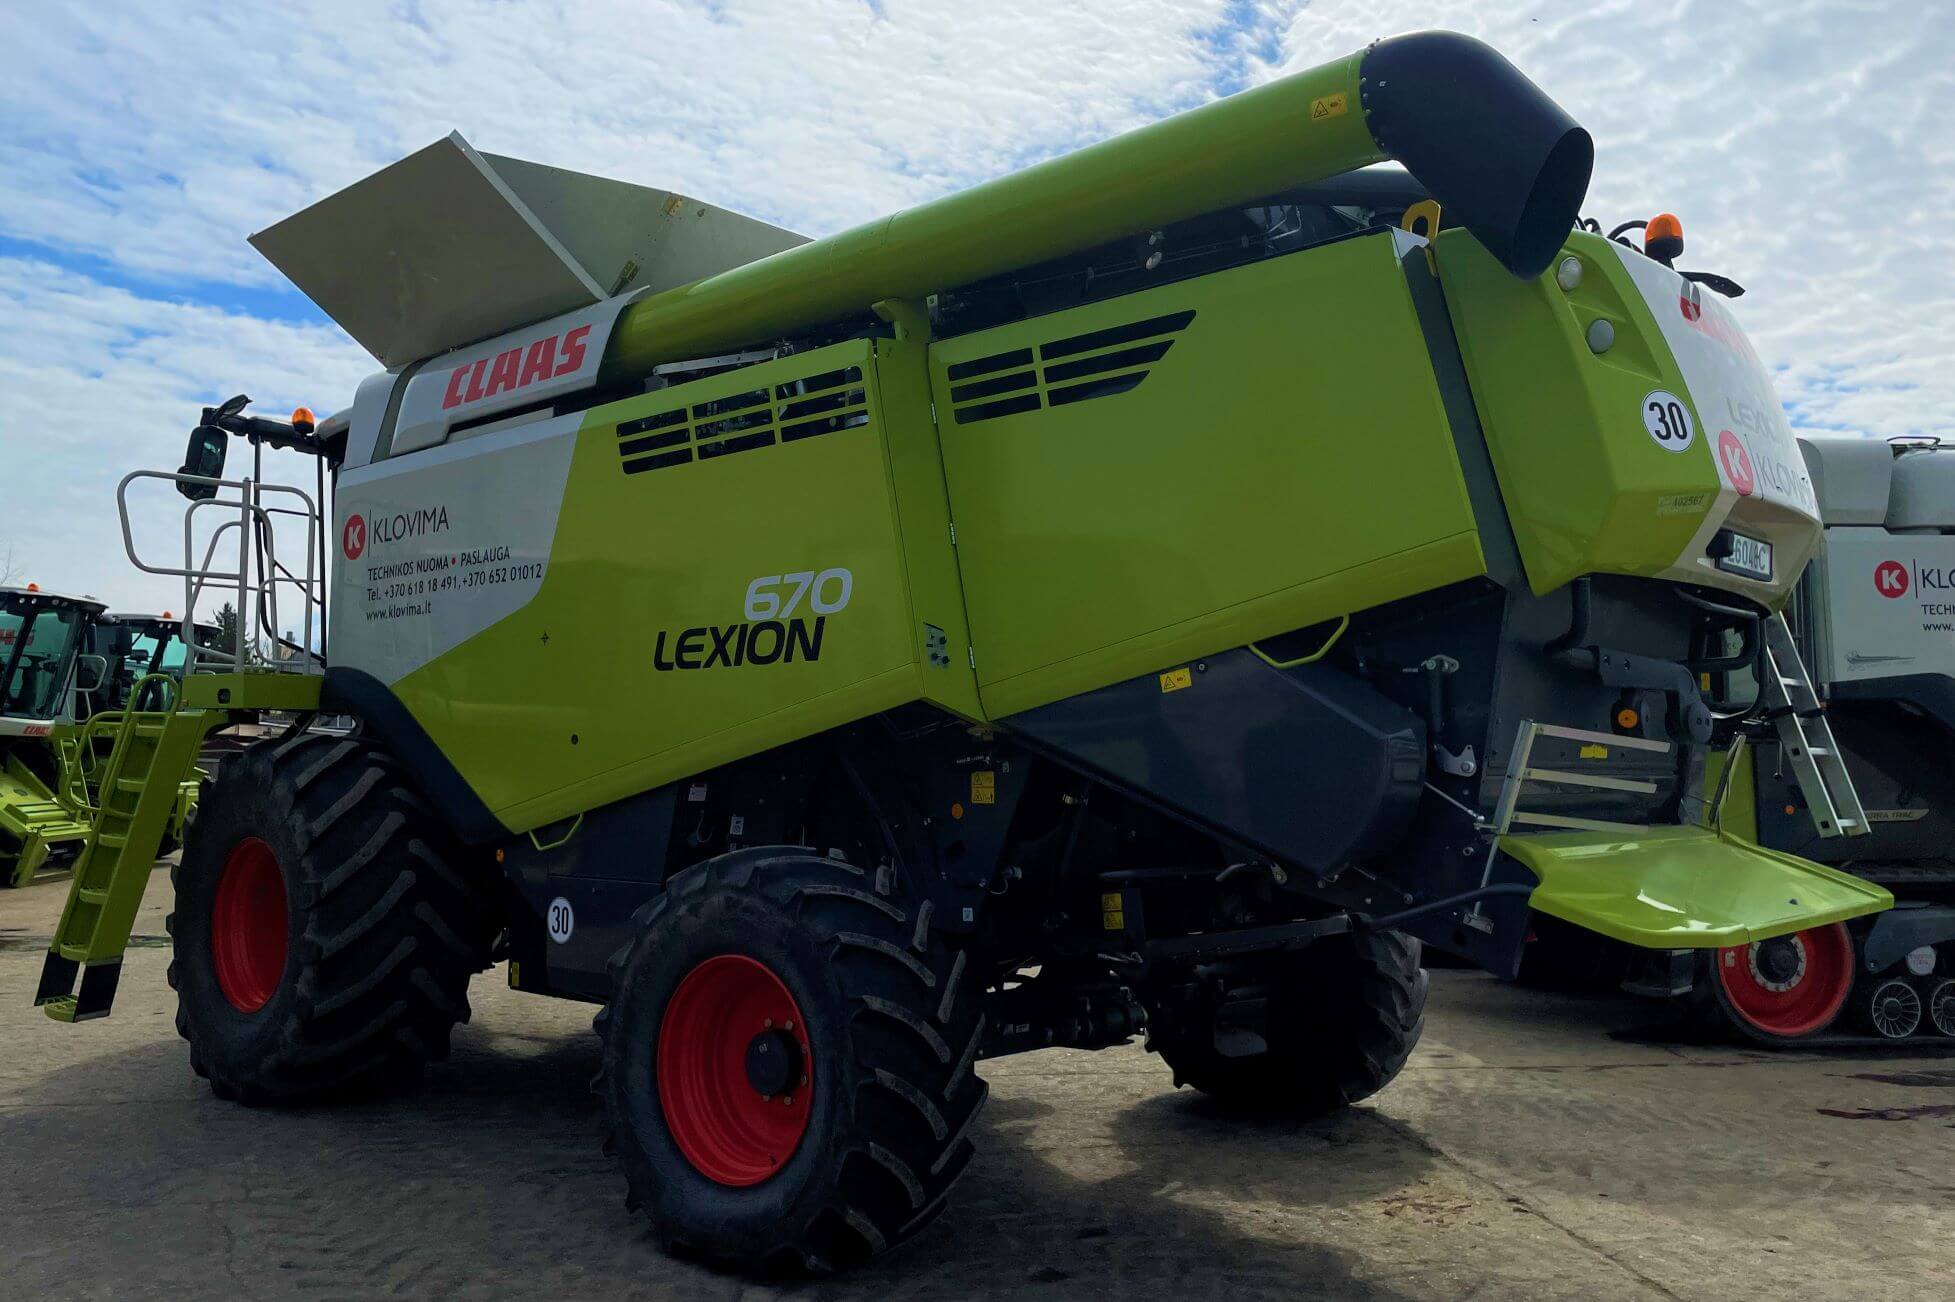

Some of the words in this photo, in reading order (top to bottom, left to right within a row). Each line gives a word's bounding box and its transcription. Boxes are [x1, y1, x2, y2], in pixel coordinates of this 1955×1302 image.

[442, 324, 592, 409] CLAAS
[1648, 402, 1687, 440] 30
[348, 525, 361, 550] K
[373, 505, 449, 544] KLOVIMA
[367, 586, 381, 602] Tel.
[384, 583, 405, 599] +370
[407, 580, 424, 597] 618
[427, 578, 438, 593] 18
[488, 567, 507, 585] 652
[510, 562, 542, 581] 01012
[368, 561, 414, 581] TECHNIKOS
[416, 555, 449, 575] NUOMA
[460, 545, 511, 567] PASLAUGA
[1881, 569, 1903, 590] K
[366, 600, 432, 621] www.klovima.lt
[744, 568, 853, 621] 670
[654, 616, 826, 671] LEXION
[552, 905, 569, 934] 30
